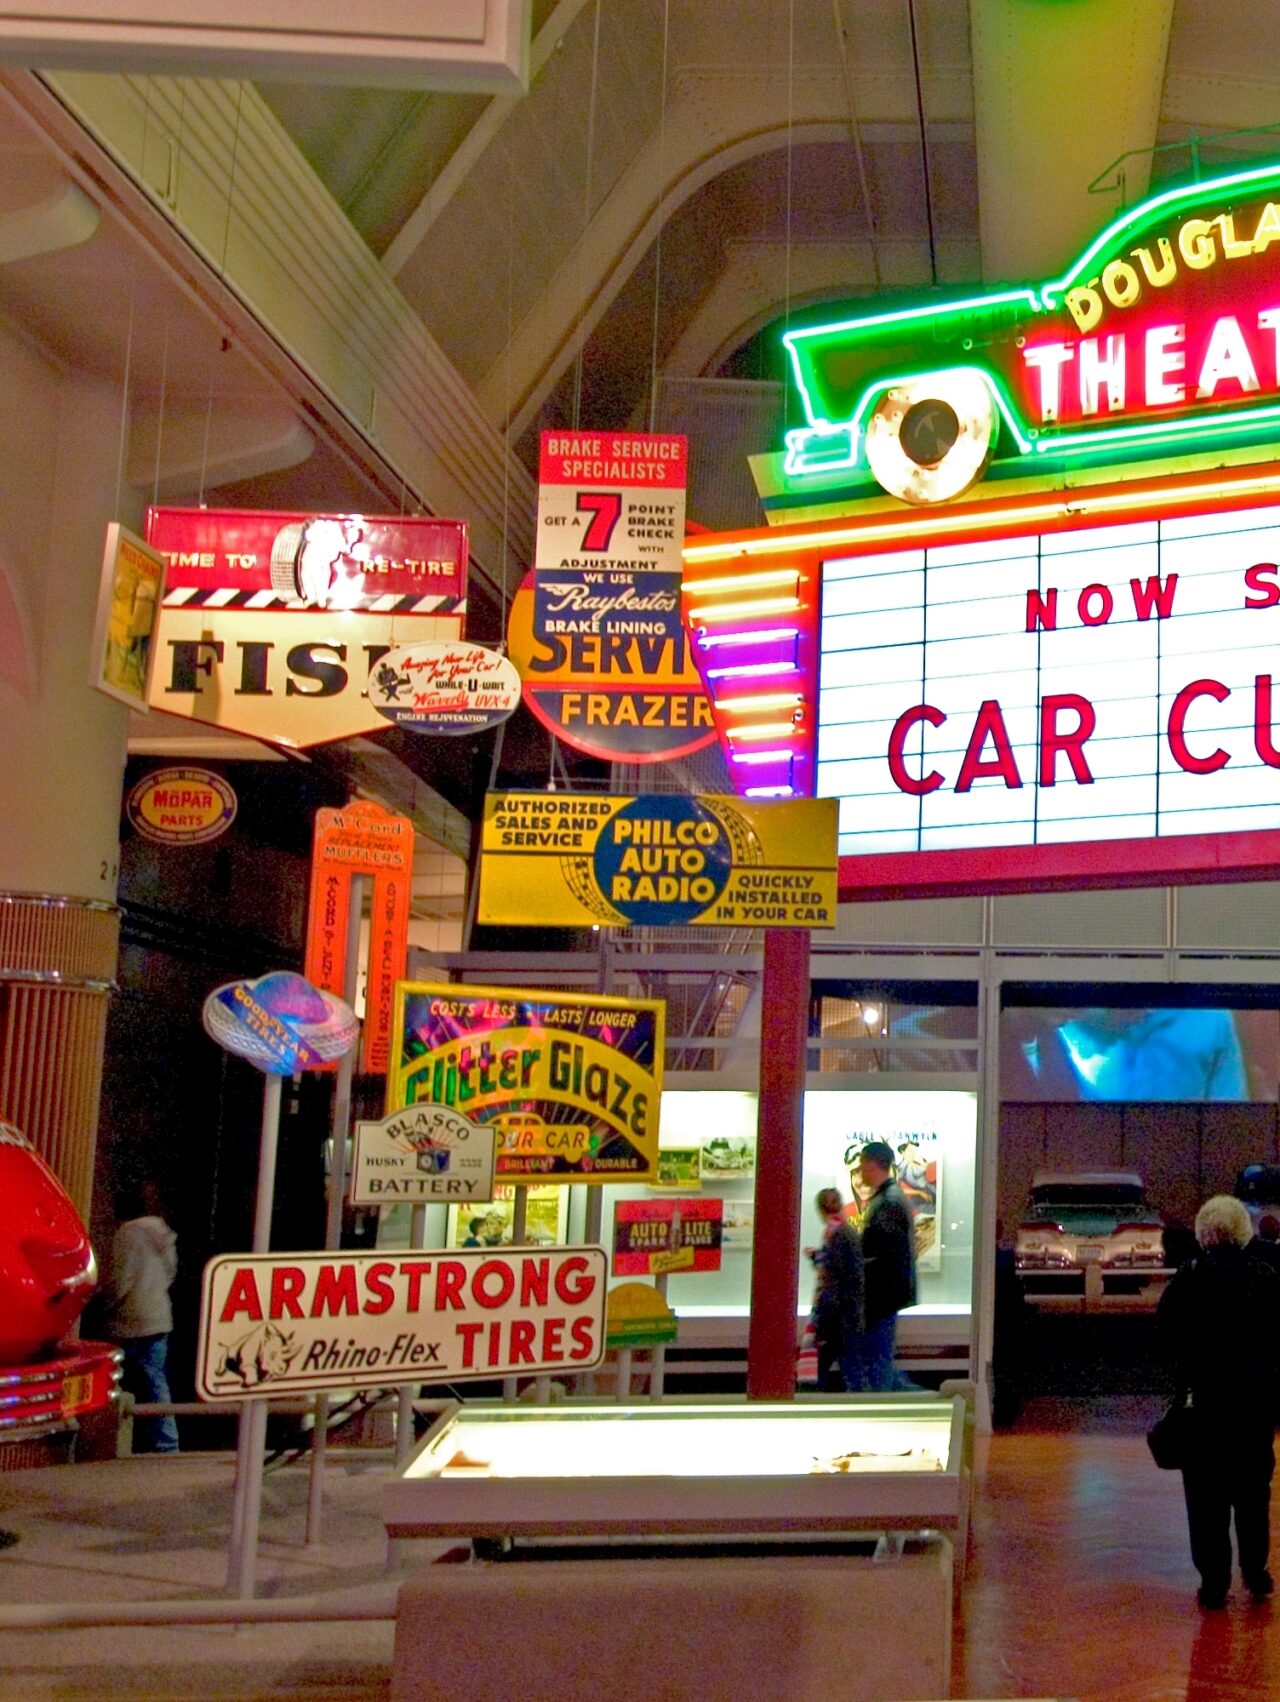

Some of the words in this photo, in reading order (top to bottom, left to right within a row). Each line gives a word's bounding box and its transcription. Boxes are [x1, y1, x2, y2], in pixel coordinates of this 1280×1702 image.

[548, 438, 601, 457] BRAKE
[612, 440, 680, 460] SERVICE
[562, 460, 666, 480] SPECIALISTS
[628, 504, 676, 515] POINT
[544, 516, 567, 526] GET
[571, 516, 581, 526] A
[576, 491, 622, 552] 7
[628, 517, 675, 527] BRAKE
[627, 529, 674, 540] CHECK
[638, 545, 664, 553] WITH
[225, 554, 256, 569] TO
[362, 555, 455, 576] RE-TIRE
[560, 558, 658, 570] ADJUSTMENT
[583, 573, 604, 584] WE
[610, 574, 633, 584] USE
[538, 582, 677, 621] Raybestos
[1025, 572, 1180, 632] NOW
[545, 620, 600, 633] BRAKE
[607, 621, 666, 634] LINING
[401, 657, 440, 673] Amazing
[441, 653, 463, 665] New
[465, 650, 485, 663] Life
[427, 669, 445, 684] for
[448, 665, 475, 682] Your
[477, 659, 502, 672] Car!
[396, 712, 426, 721] ENGINE
[429, 713, 488, 722] REJUVENATION
[561, 694, 715, 727] FRAZER
[887, 693, 1096, 794] CAR
[493, 801, 612, 815] AUTHORIZED
[160, 814, 203, 826] PARTS
[495, 816, 553, 830] SALES
[556, 817, 598, 831] AND
[501, 832, 583, 847] SERVICE
[613, 819, 719, 846] PHILCO
[326, 846, 402, 864] MUFFLERS
[619, 848, 705, 874] AUTO
[612, 876, 715, 903] RADIO
[738, 875, 814, 889] QUICKLY
[729, 890, 823, 905] INSTALLED
[716, 906, 735, 920] IN
[738, 906, 787, 920] YOUR
[792, 908, 828, 922] CAR
[430, 1000, 476, 1018] COSTS
[483, 1003, 516, 1020] LESS
[543, 1008, 582, 1024] LASTS
[588, 1010, 636, 1028] LONGER
[234, 986, 309, 1063] GOODYEAR
[246, 1013, 285, 1054] TIRES
[386, 1113, 470, 1141] BLASCO
[545, 1132, 588, 1148] CAR
[366, 1157, 406, 1167] HUSKY
[504, 1157, 555, 1170] BRILLIANT
[595, 1158, 638, 1170] DURABLE
[369, 1179, 479, 1193] BATTERY
[629, 1222, 668, 1237] AUTO
[685, 1221, 711, 1236] LITE
[628, 1237, 667, 1247] SPARK
[685, 1236, 713, 1245] PLUGS
[218, 1256, 597, 1323] ARMSTRONG
[455, 1316, 595, 1369] TIRES
[301, 1333, 442, 1372] Rhino-Flex
